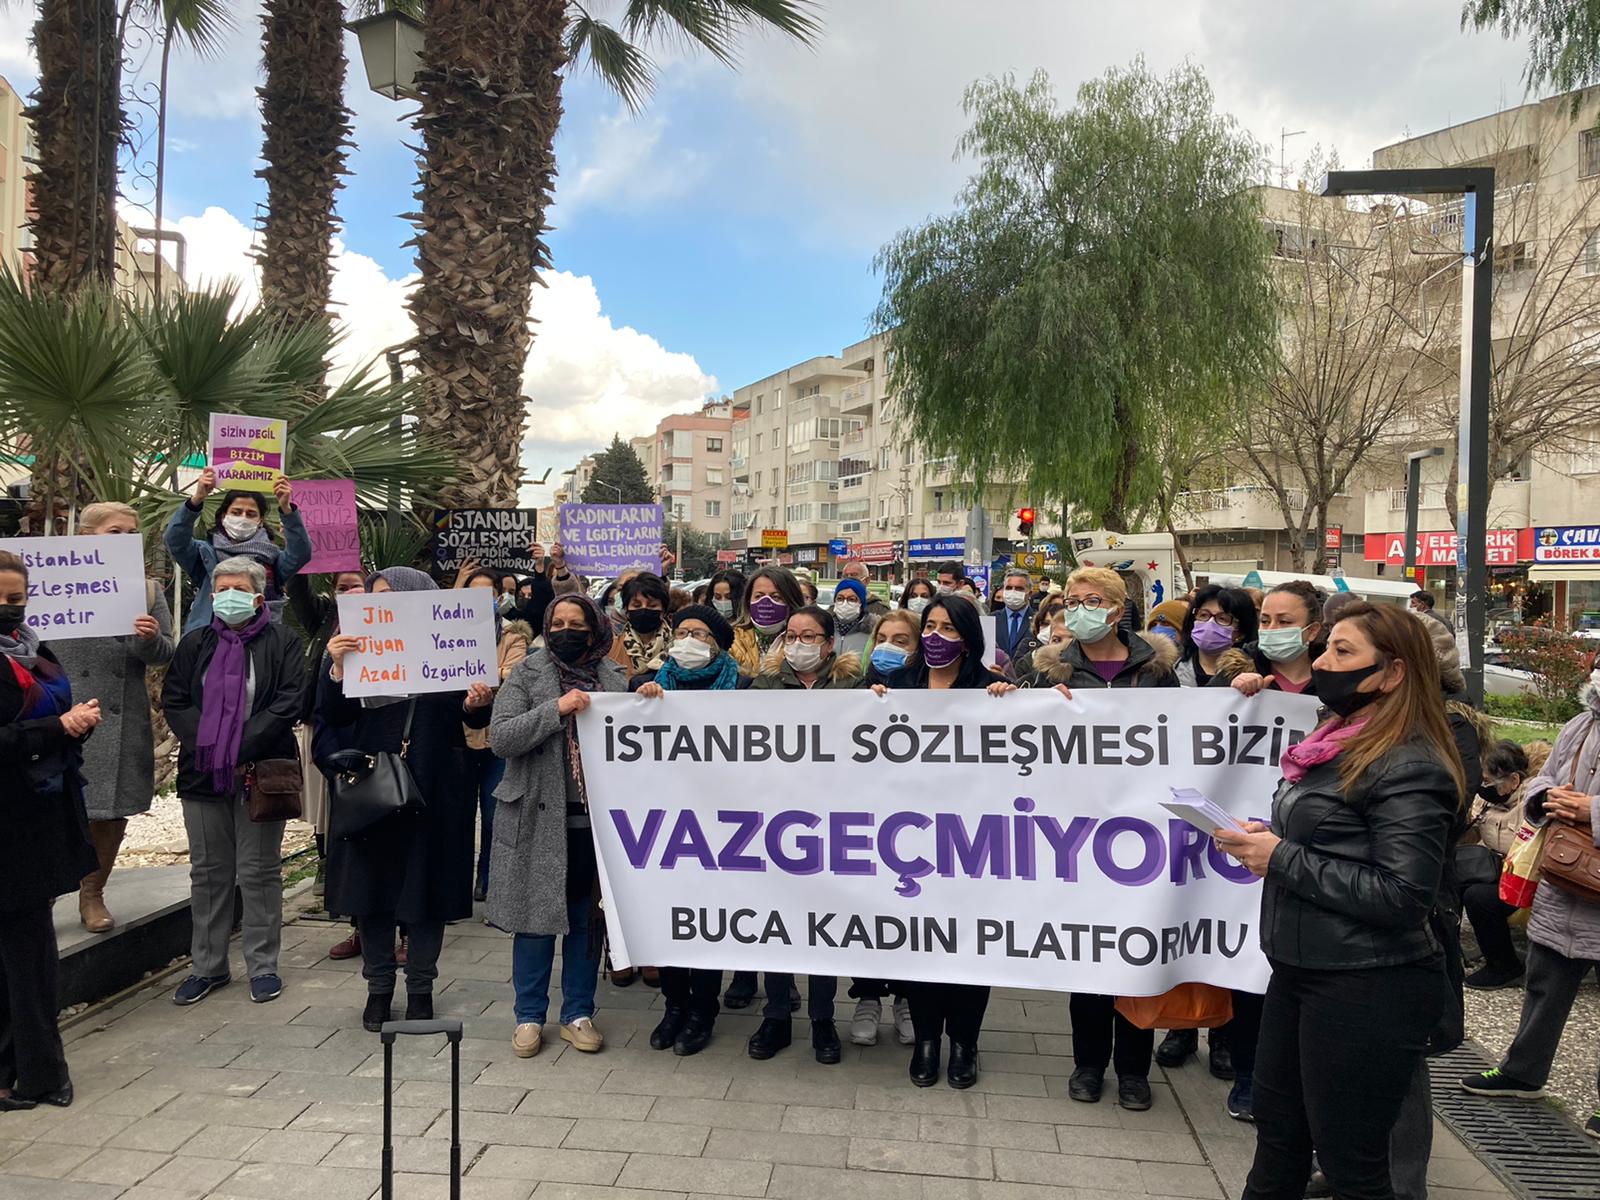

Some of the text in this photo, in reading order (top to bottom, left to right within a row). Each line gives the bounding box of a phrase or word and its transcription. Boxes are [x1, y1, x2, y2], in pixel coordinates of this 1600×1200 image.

[449, 510, 535, 531] İSTANBUL
[565, 508, 656, 526] KADINLARIN
[563, 529, 581, 542] VE
[1429, 531, 1516, 548] ELERİK
[1562, 528, 1600, 545] ÇAV
[1432, 548, 1512, 563] MAET
[1544, 547, 1589, 559] BÖREK
[28, 576, 119, 598] zleşmesi
[27, 608, 95, 630] aşatır
[362, 606, 394, 625] Jin
[432, 603, 474, 621] Kadın
[357, 636, 404, 656] Jiyan
[431, 633, 477, 651] Yaşam
[359, 664, 407, 682] Azadi
[422, 660, 487, 682] Özgürlük
[605, 715, 835, 763] İSTANBUL
[851, 713, 1169, 777] SÖZLEŞMESİ
[671, 907, 1249, 967] BUCA KADIN PLATFORMU
